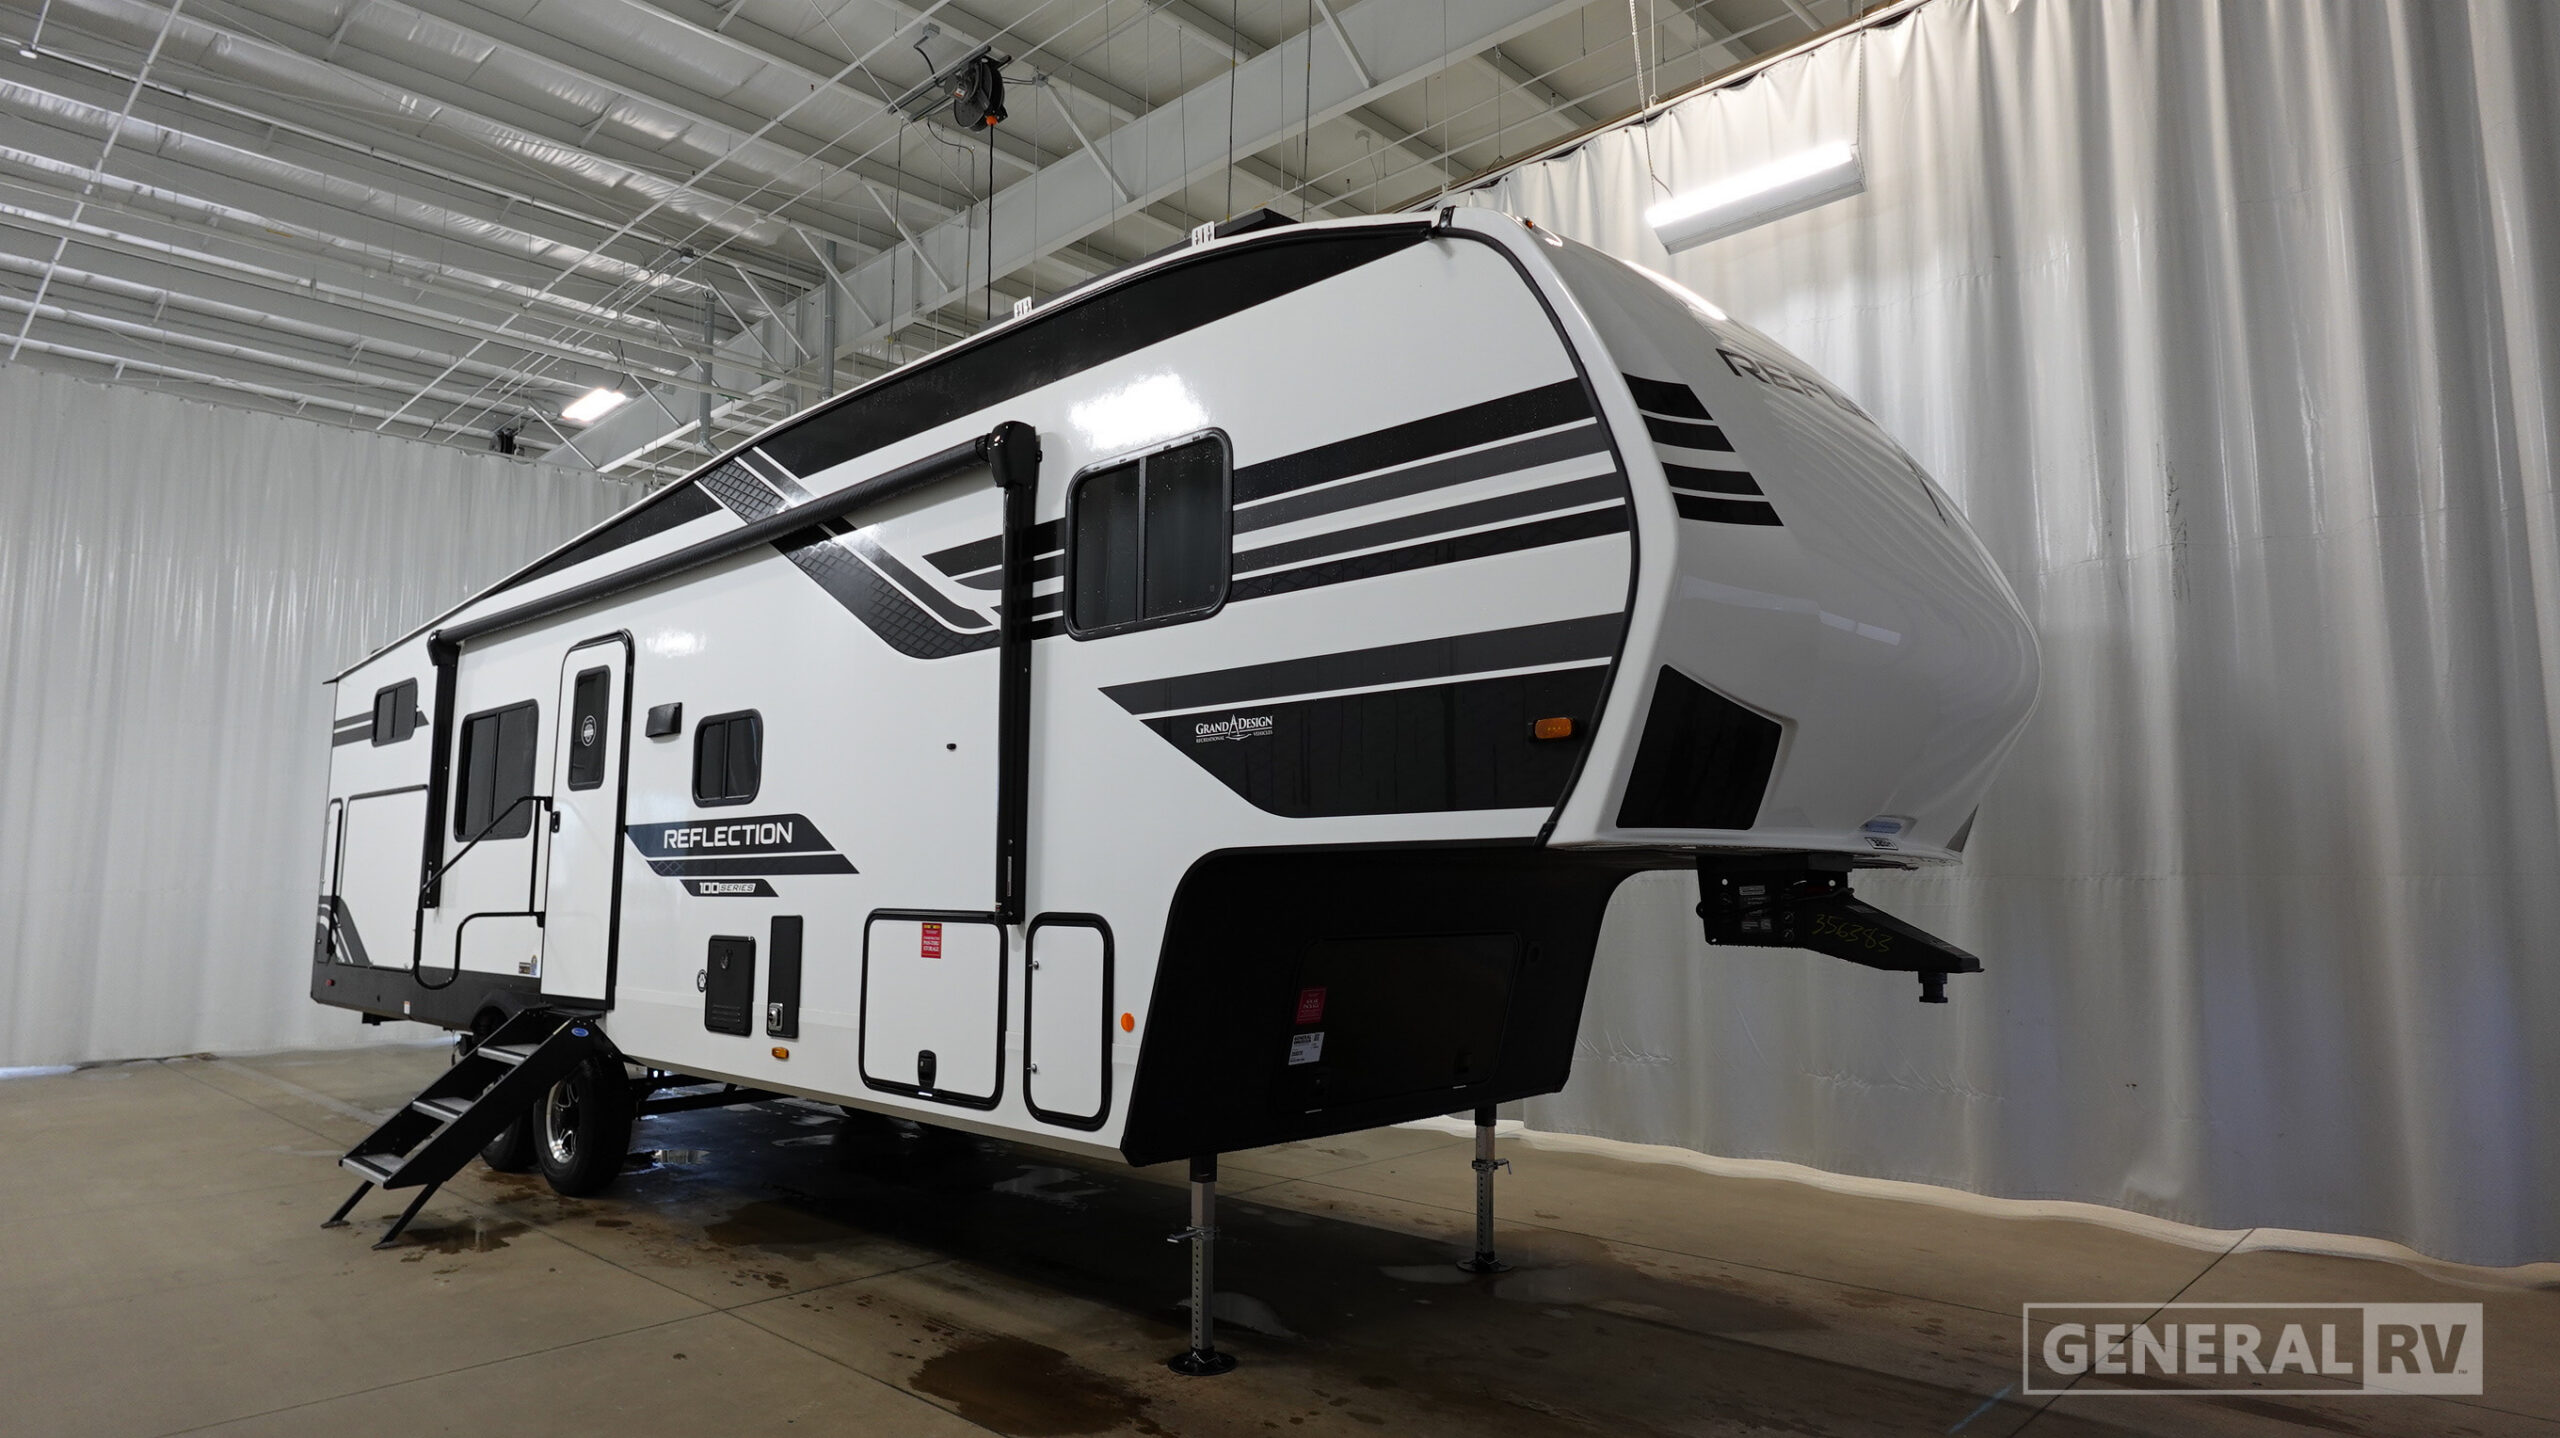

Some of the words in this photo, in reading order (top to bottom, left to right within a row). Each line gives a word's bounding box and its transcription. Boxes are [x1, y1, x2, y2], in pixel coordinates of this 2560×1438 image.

[1195, 722, 1229, 735] GRAND
[1238, 716, 1273, 730] DESIGN
[664, 822, 793, 849] REFLECTION
[720, 884, 755, 892] SERIES
